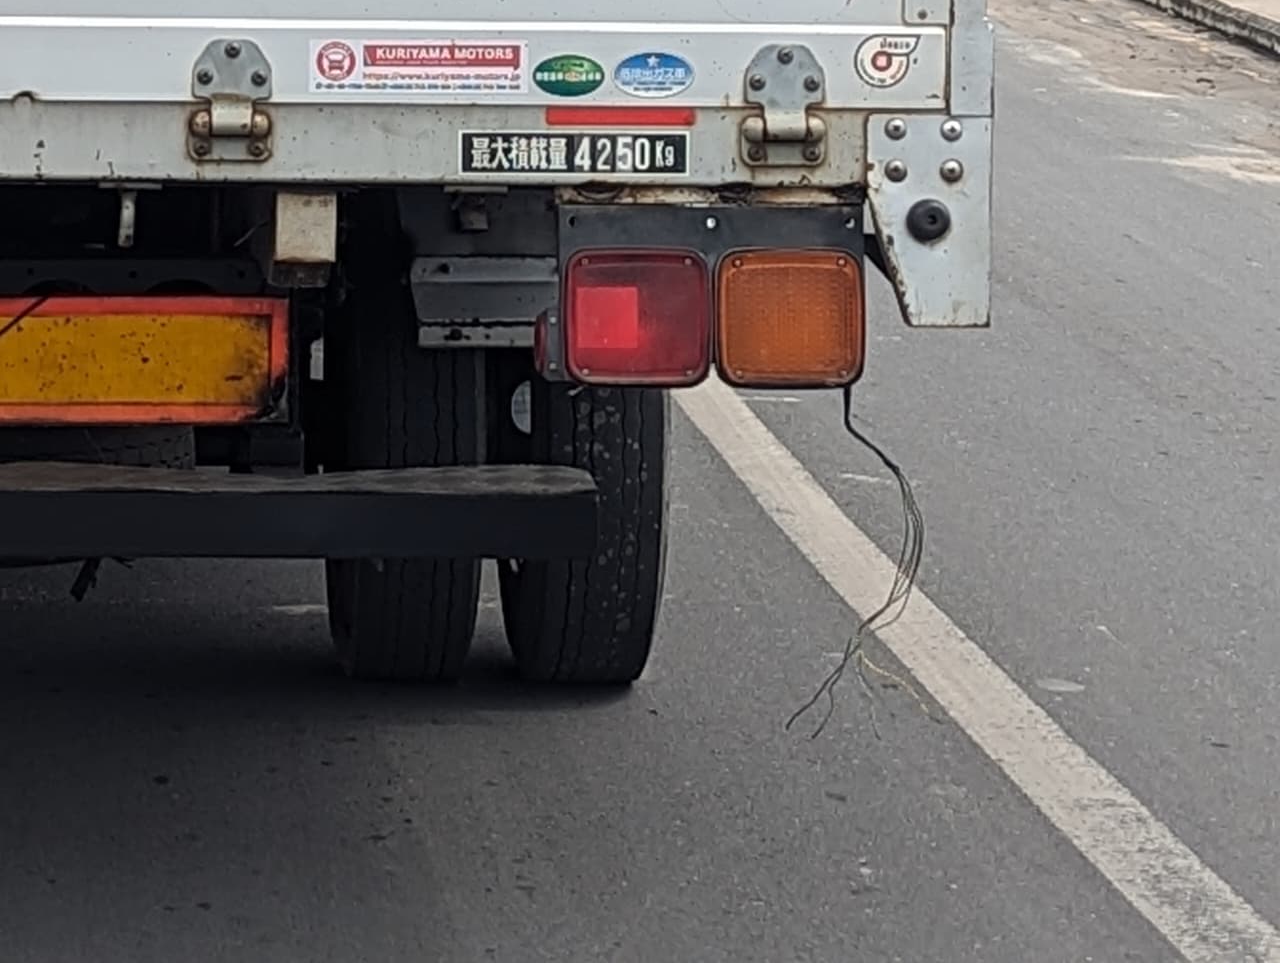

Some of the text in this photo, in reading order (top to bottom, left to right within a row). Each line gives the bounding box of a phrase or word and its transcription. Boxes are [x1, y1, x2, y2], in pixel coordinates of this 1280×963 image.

[375, 47, 514, 61] KURIYAMA MOTORS
[471, 137, 568, 170] 最大積載量
[574, 136, 651, 171] 4250
